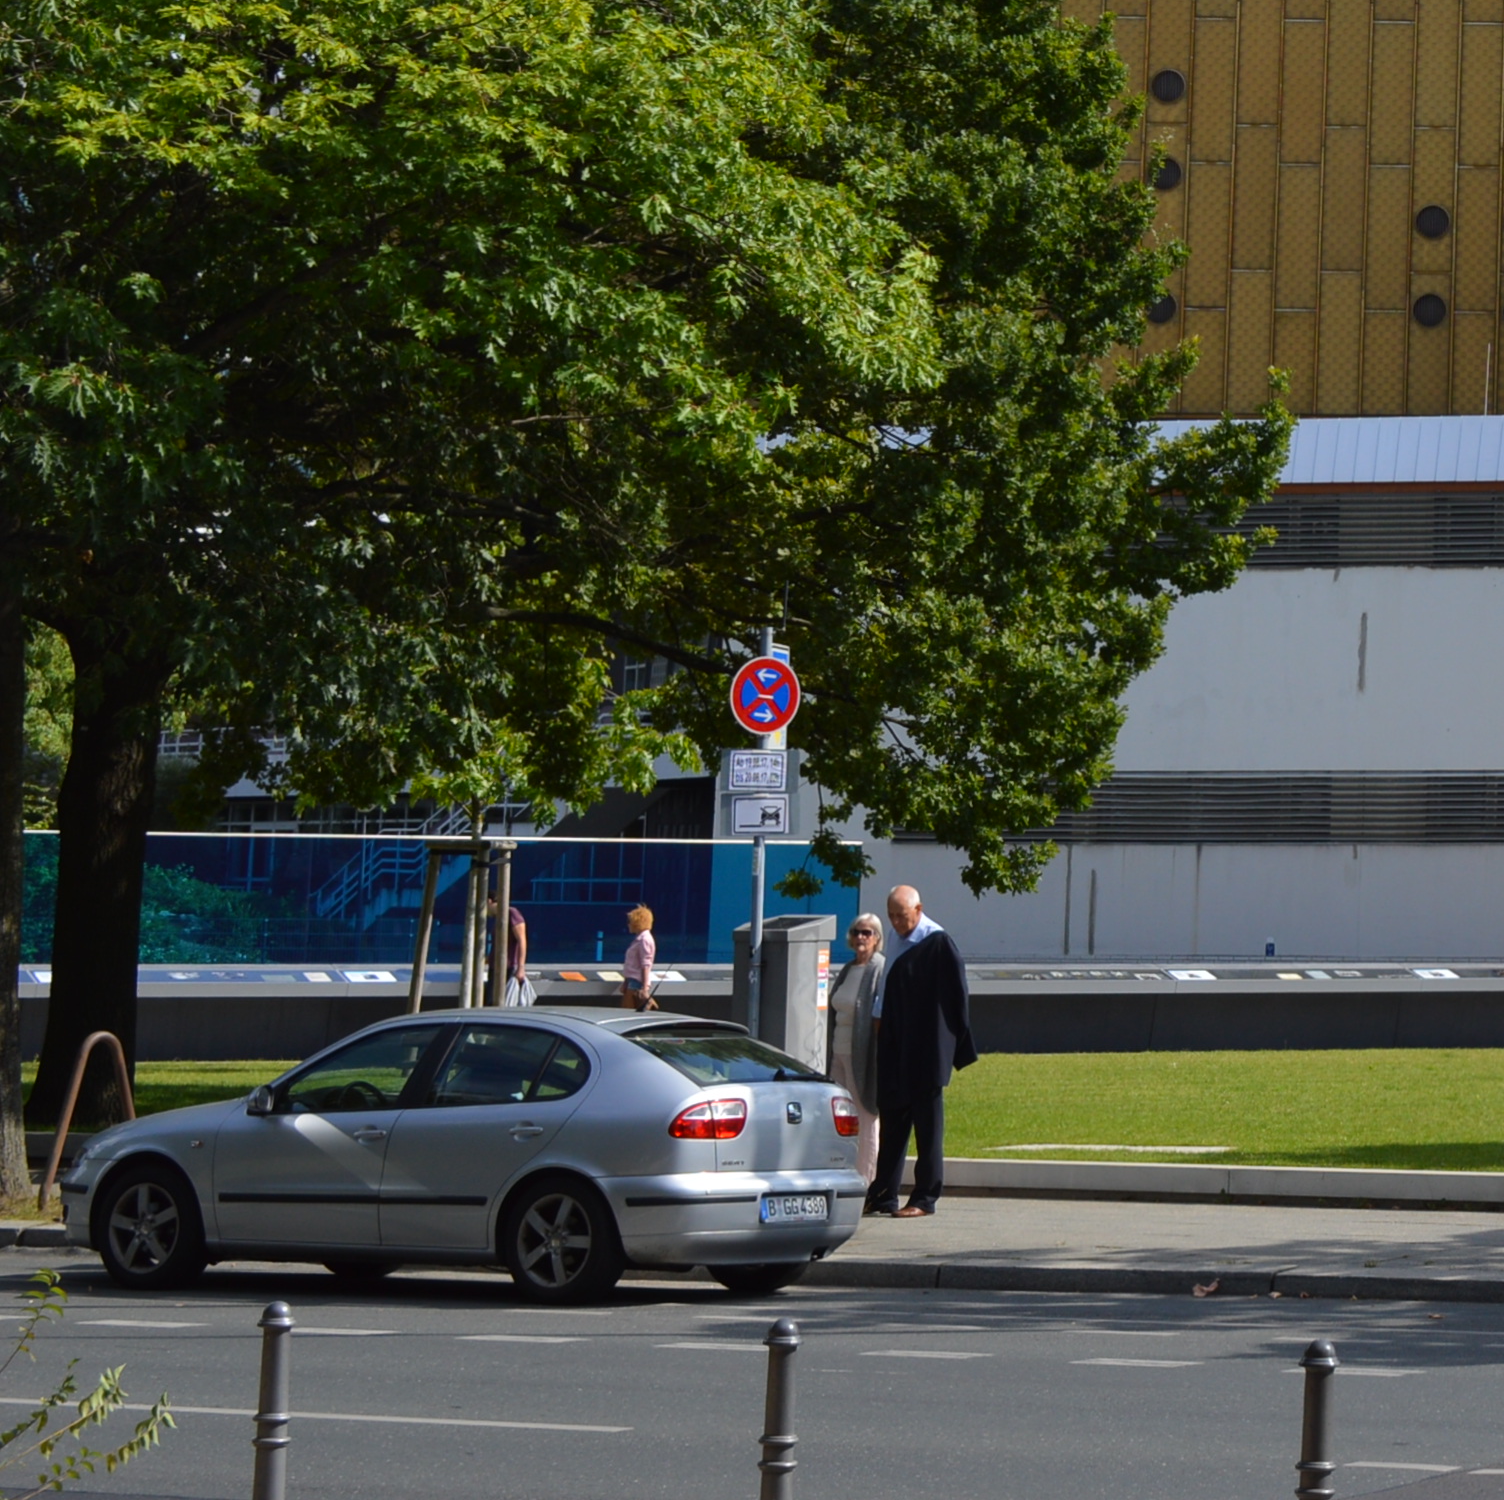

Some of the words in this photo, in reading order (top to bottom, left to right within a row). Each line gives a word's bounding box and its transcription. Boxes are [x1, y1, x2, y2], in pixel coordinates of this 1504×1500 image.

[768, 1199, 776, 1216] B
[783, 1198, 799, 1215] GG
[801, 1197, 825, 1214] 4389
